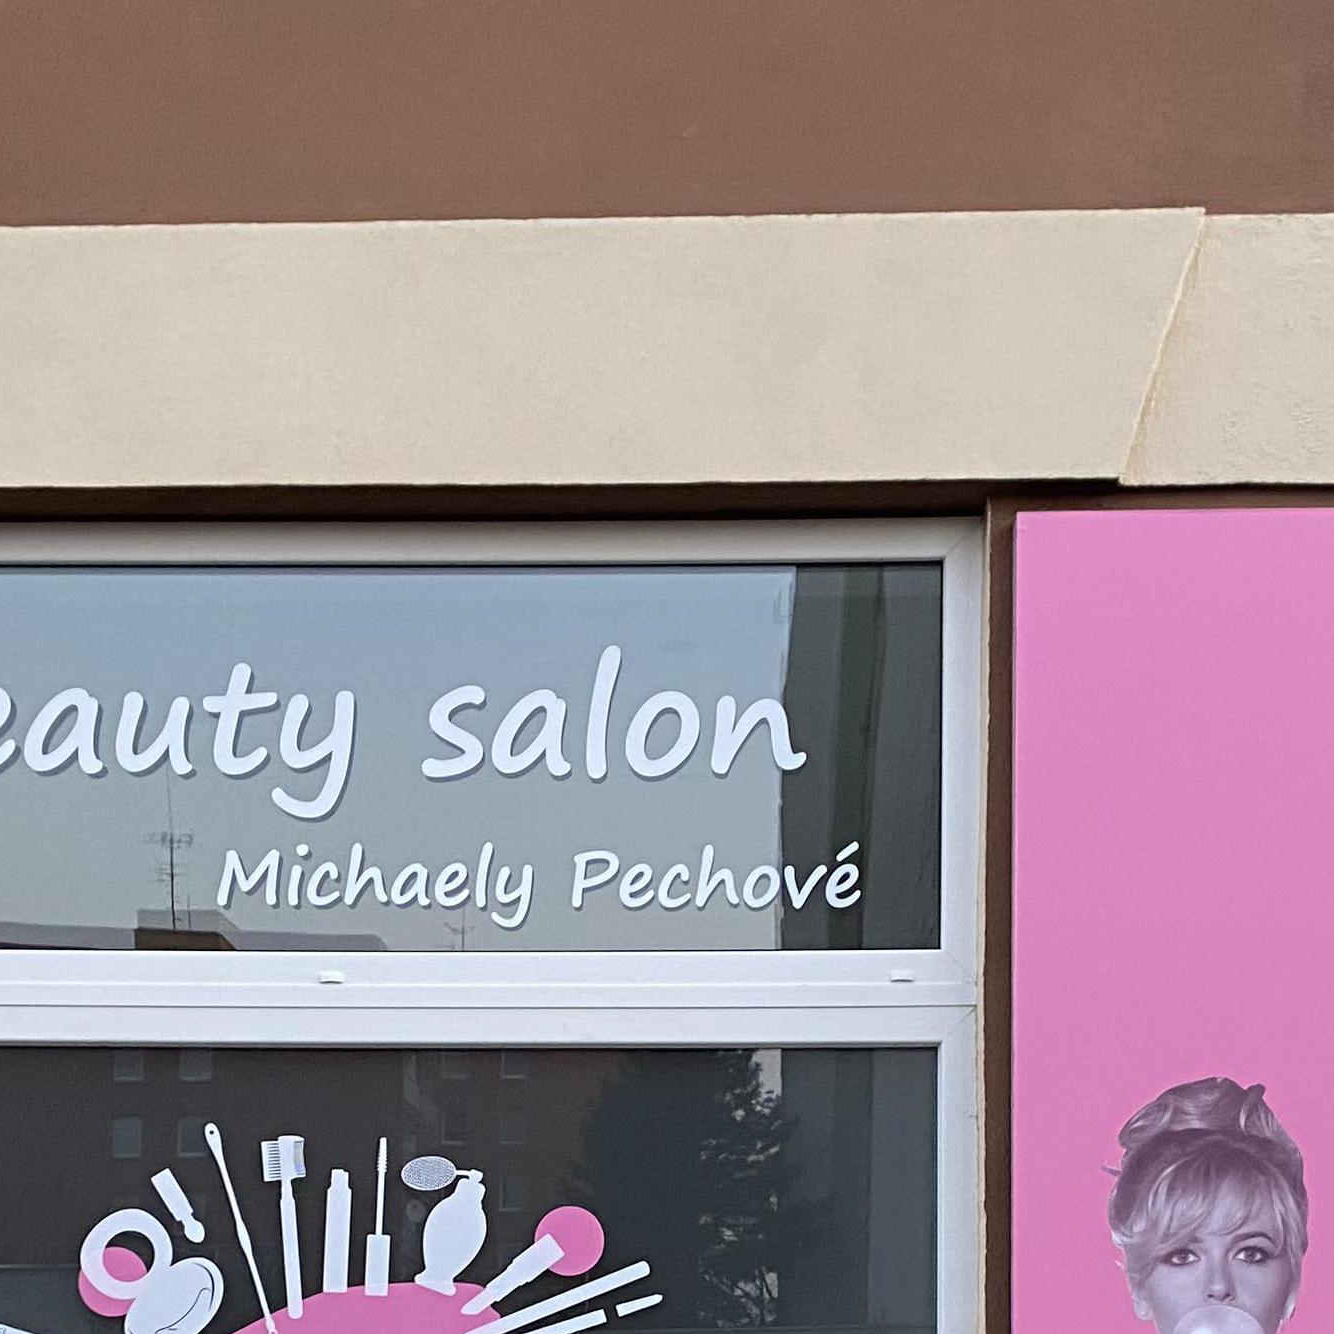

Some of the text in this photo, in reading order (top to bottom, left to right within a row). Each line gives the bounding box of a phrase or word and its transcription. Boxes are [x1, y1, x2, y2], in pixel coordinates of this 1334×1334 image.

[421, 645, 807, 779] salon
[216, 841, 861, 928] Michaely Pechové
